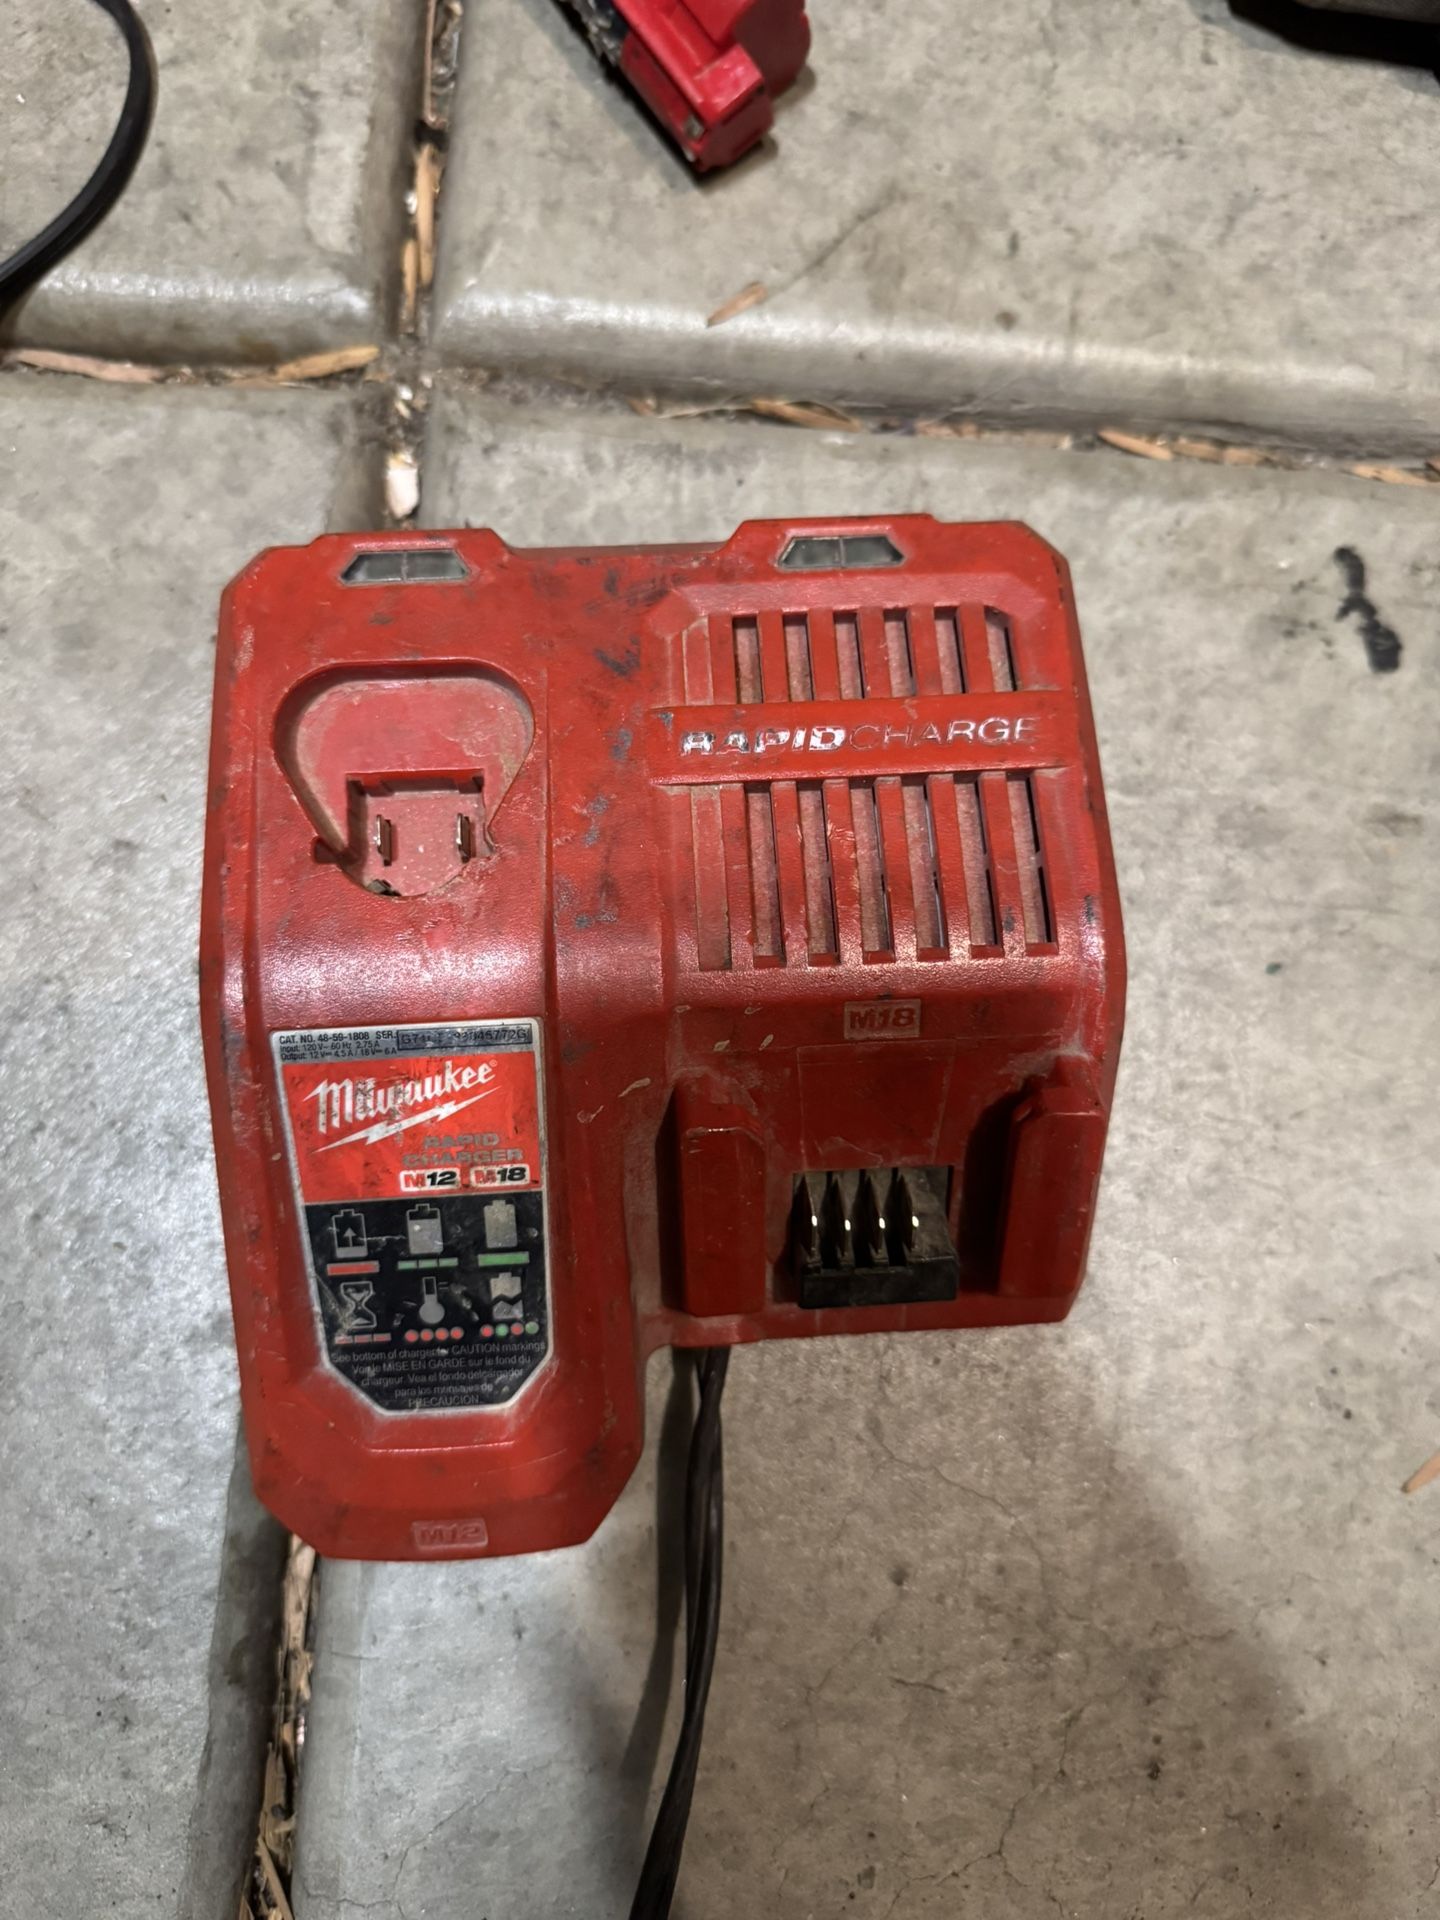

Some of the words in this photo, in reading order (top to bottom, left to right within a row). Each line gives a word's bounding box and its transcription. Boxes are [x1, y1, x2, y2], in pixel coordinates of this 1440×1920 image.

[849, 1007, 915, 1029] M18
[280, 1034, 298, 1044] CAT.
[300, 1034, 315, 1043] NO.
[317, 1031, 369, 1042] 48-59-1808
[375, 1030, 397, 1040] SER.
[303, 1043, 317, 1052] 120
[330, 1042, 340, 1050] 60
[310, 1051, 319, 1059] 12
[360, 1047, 369, 1056] 18
[303, 1061, 496, 1134] Milwaukee
[424, 1132, 499, 1149] RAPID
[402, 1148, 523, 1168] CHARGER
[404, 1171, 457, 1188] M12
[474, 1167, 526, 1184] M18
[331, 1353, 351, 1362] See
[353, 1350, 386, 1360] bottom
[387, 1349, 397, 1359] of
[451, 1343, 500, 1355] CAUTION
[502, 1341, 545, 1354] markings
[383, 1360, 408, 1372] MISE
[411, 1360, 426, 1370] EN
[428, 1358, 466, 1369] GARDE
[468, 1359, 482, 1367] sur
[496, 1355, 517, 1365] fond
[518, 1355, 531, 1364] du
[407, 1373, 425, 1382] Vea
[439, 1371, 466, 1381] fondo
[394, 1388, 416, 1398] para
[420, 1523, 482, 1543] M12
